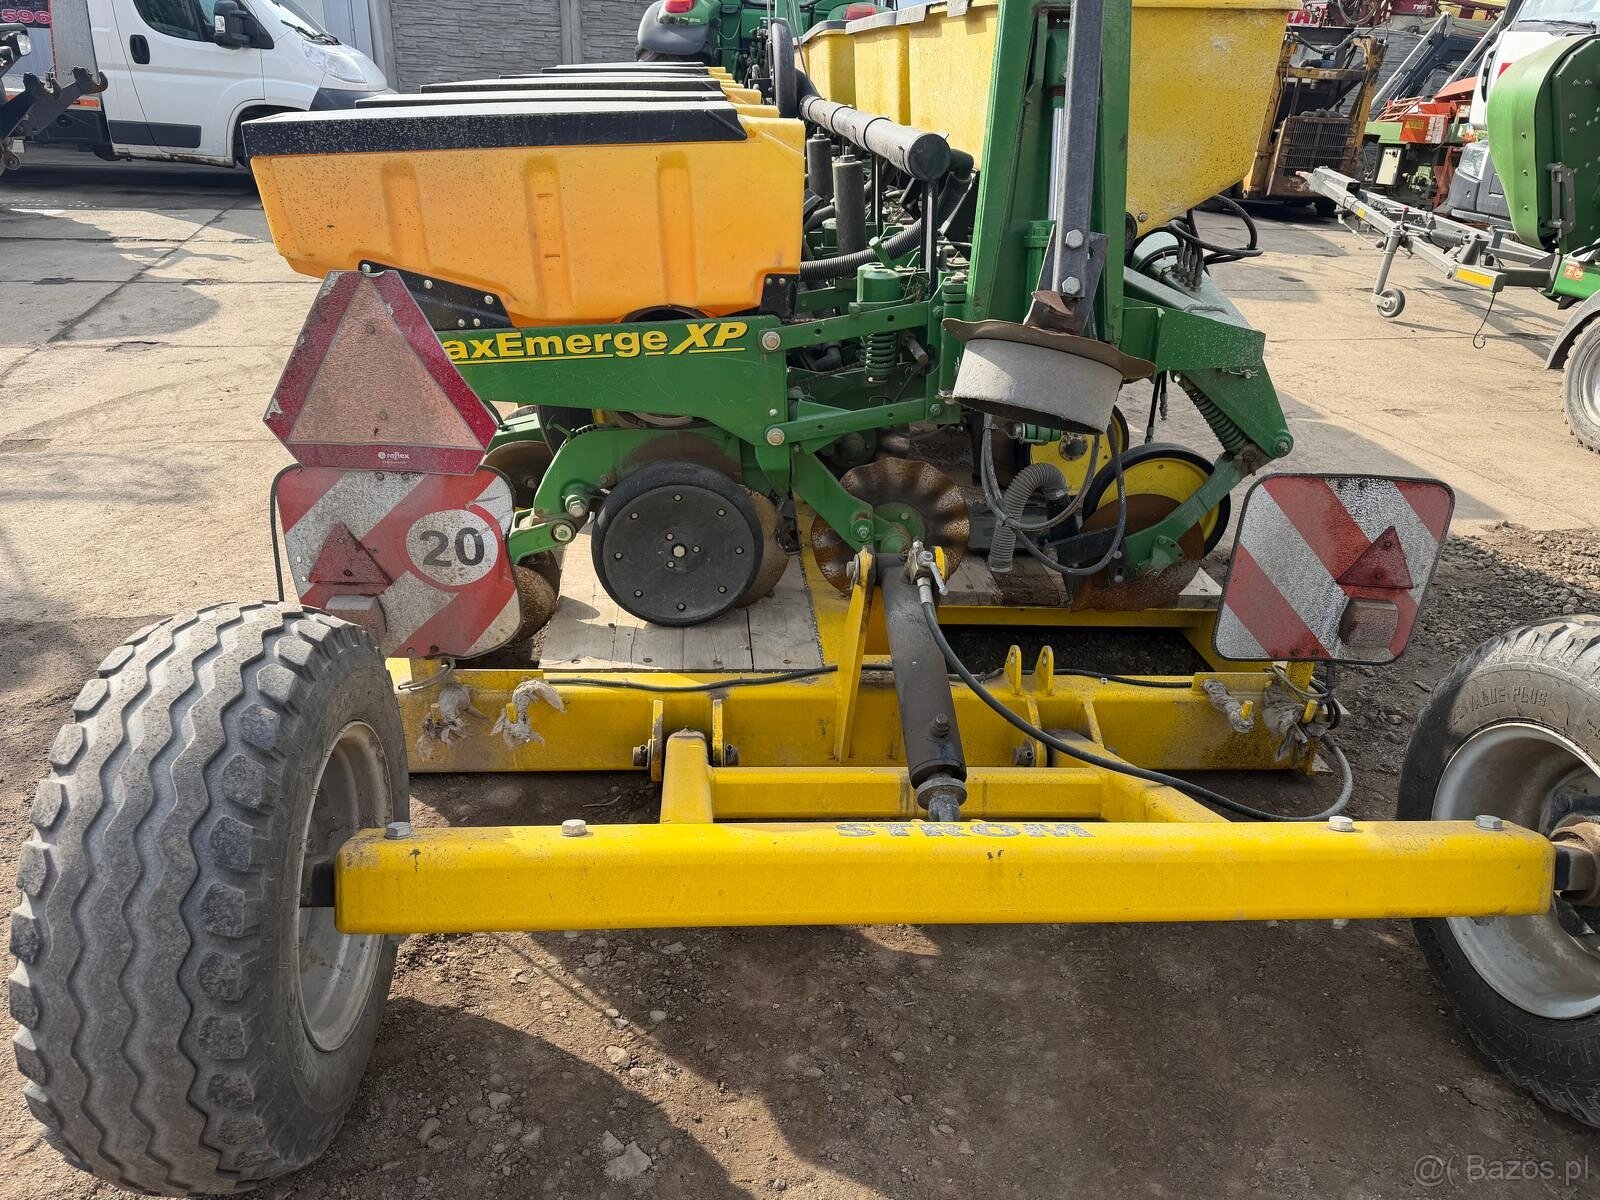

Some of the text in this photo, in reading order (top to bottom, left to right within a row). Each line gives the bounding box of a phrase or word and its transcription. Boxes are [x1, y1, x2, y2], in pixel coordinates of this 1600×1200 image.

[2, 8, 52, 24] 596
[441, 321, 748, 358] axEmerge XP
[420, 527, 485, 567] 20
[1513, 687, 1548, 708] PLUS
[835, 822, 1096, 838] STROM
